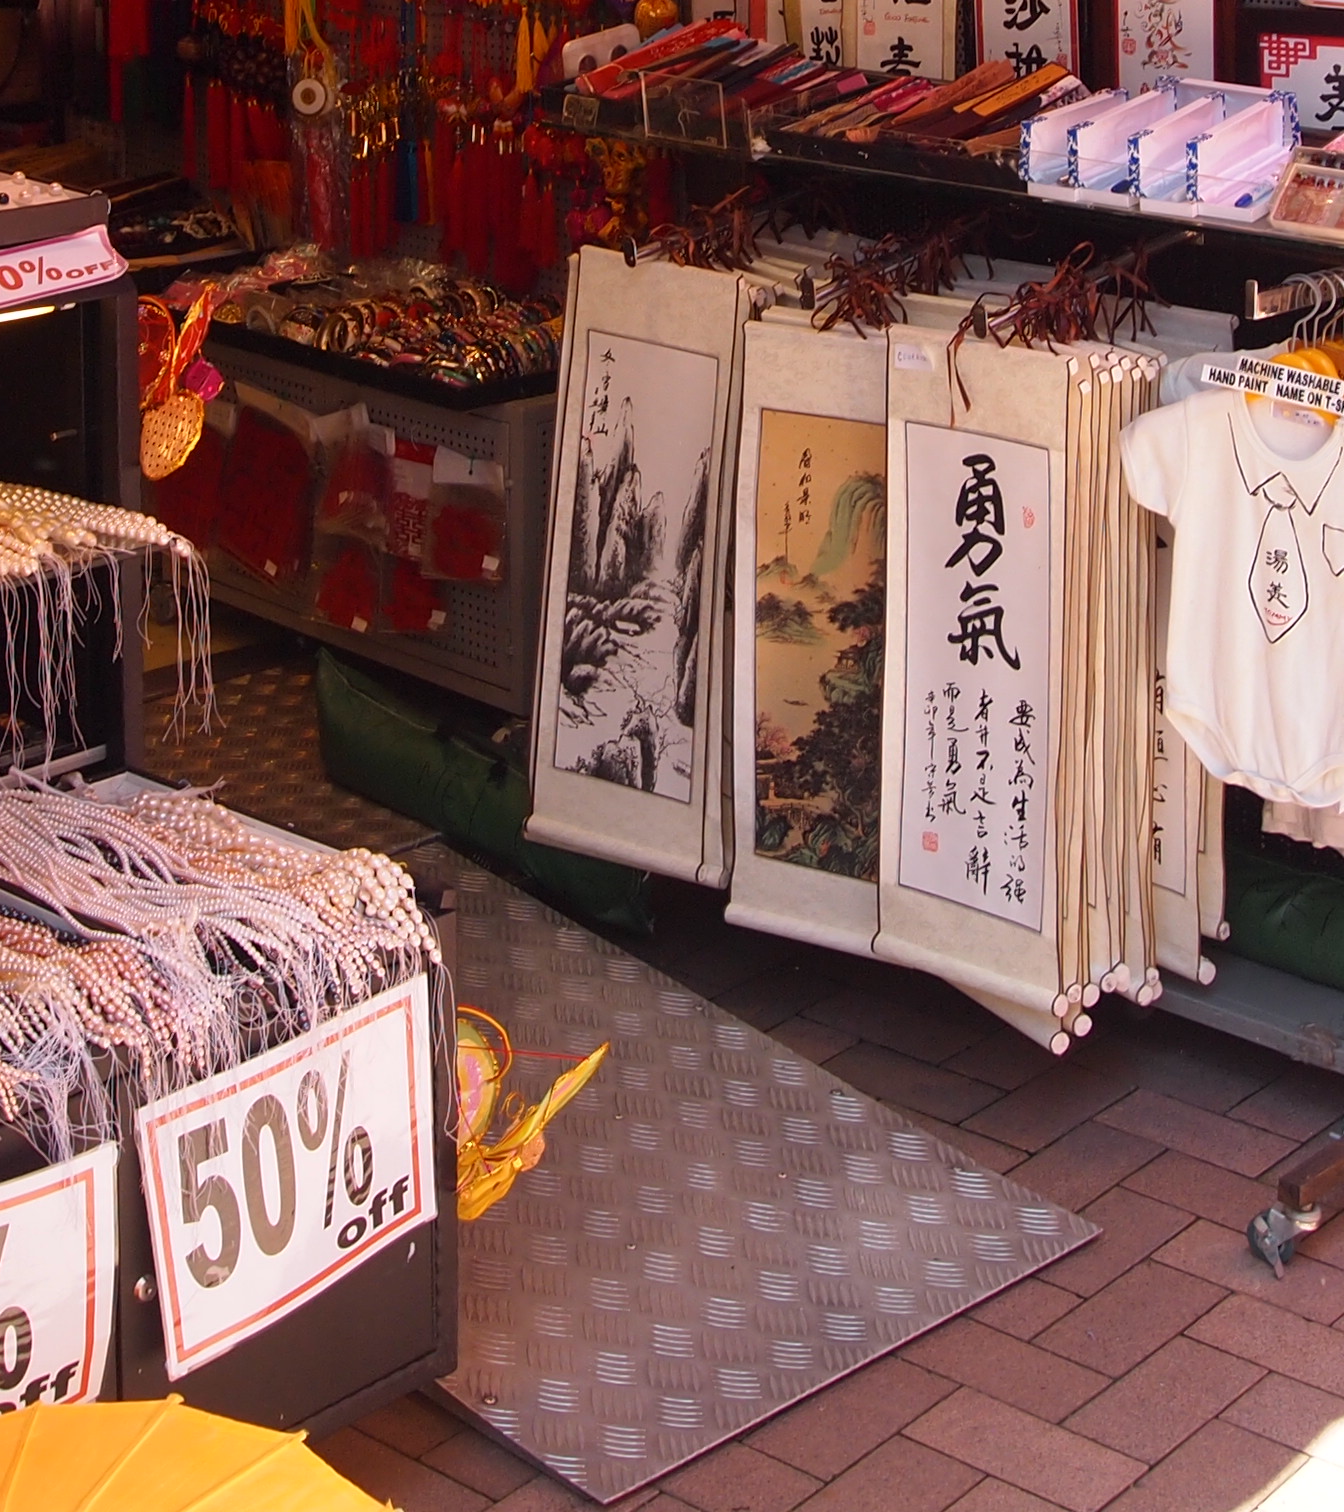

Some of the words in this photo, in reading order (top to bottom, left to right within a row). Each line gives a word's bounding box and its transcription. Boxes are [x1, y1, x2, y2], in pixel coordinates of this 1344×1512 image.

[64, 259, 117, 280] OFF
[1209, 367, 1237, 387] HAND
[1237, 375, 1269, 393] PAINT
[1276, 384, 1305, 403] NAME
[1307, 391, 1323, 407] ON
[1240, 357, 1285, 381] MACHINE
[1286, 369, 1342, 395] WASHABLE
[945, 453, 1022, 671] 勇氣
[179, 1048, 376, 1290] 50%
[336, 1174, 411, 1251] off
